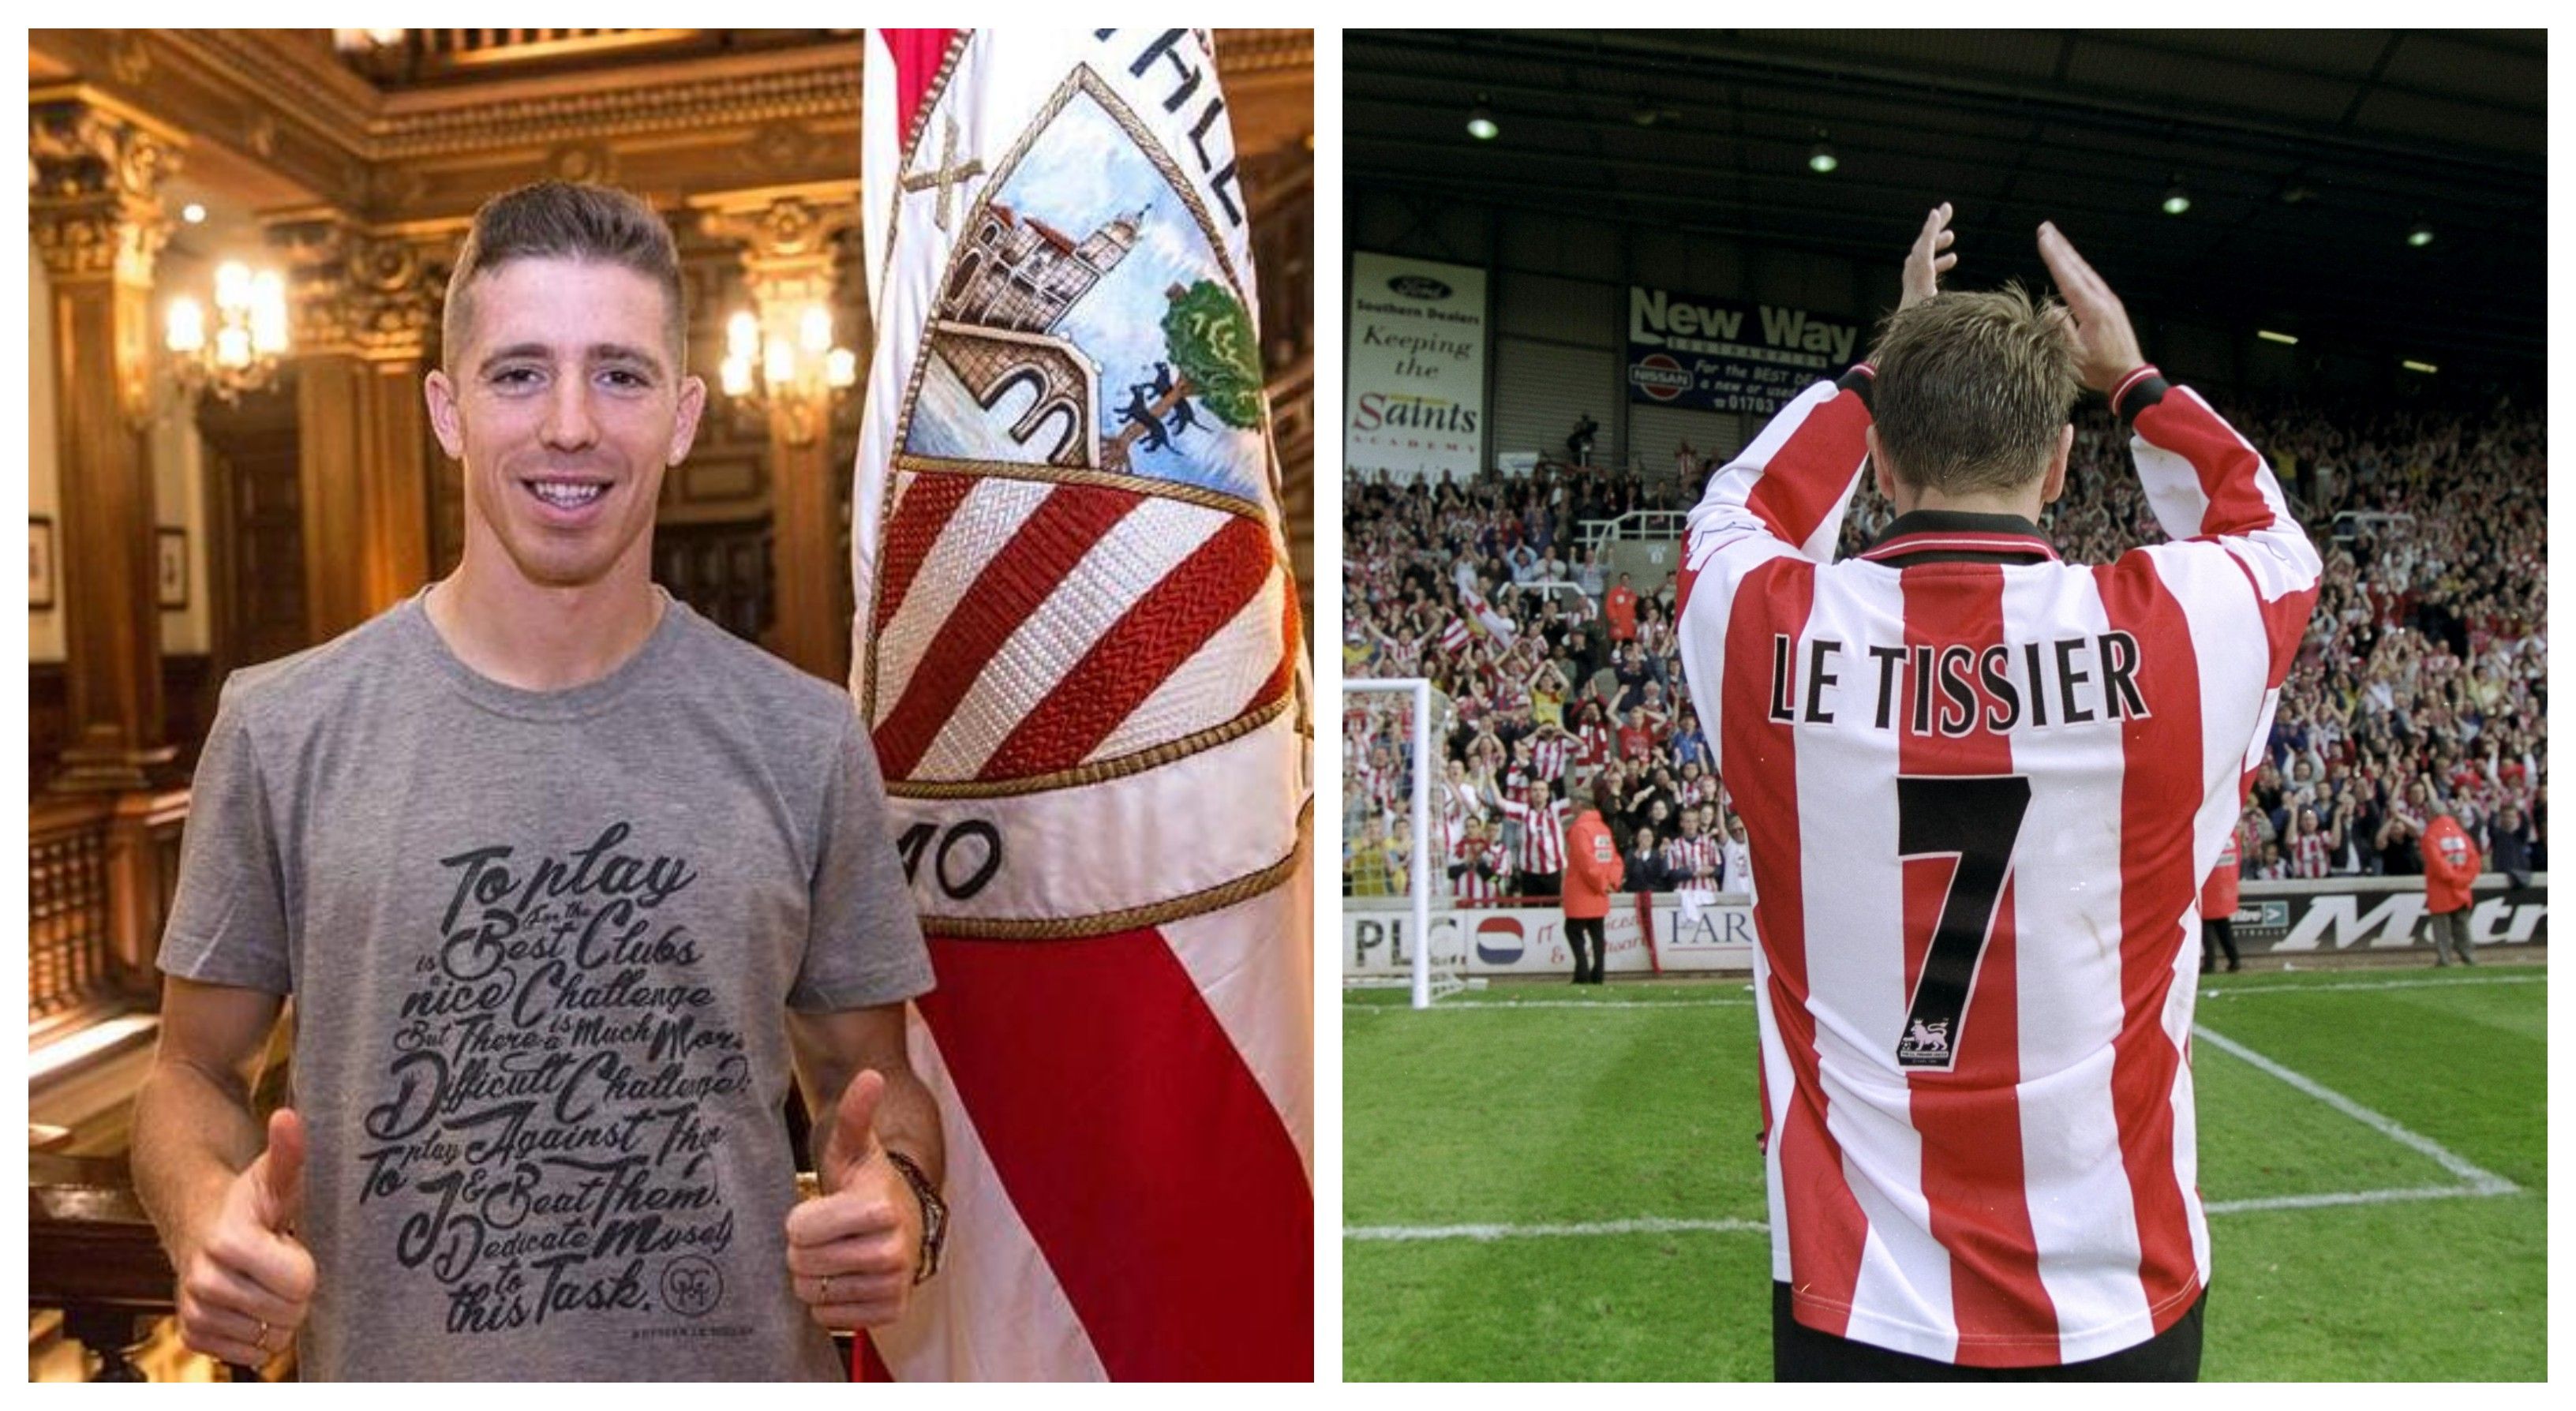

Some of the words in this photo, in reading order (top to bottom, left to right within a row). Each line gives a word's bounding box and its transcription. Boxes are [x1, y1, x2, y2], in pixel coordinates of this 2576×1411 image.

[1363, 325, 1473, 359] Keeping
[1630, 286, 1743, 341] New
[1759, 305, 1857, 365] Way
[1395, 357, 1439, 378] the
[1633, 369, 1689, 386] NISSAN
[1714, 380, 1743, 393] new
[1753, 366, 1791, 384] BEST
[1354, 392, 1477, 433] Saints
[1768, 634, 1842, 725] LE
[1868, 630, 2152, 738] TISSIER
[440, 845, 522, 936] To
[515, 822, 697, 914] play
[440, 908, 578, 981] Best
[576, 899, 703, 970] Clubs
[1896, 774, 2032, 1072] 7
[400, 967, 517, 1018] nice
[511, 960, 715, 1028] Challenge
[394, 1020, 451, 1051] But
[453, 1013, 541, 1067] There
[571, 1012, 654, 1048] Much
[365, 1050, 578, 1140] Difficult
[359, 1147, 408, 1204] To
[402, 1130, 462, 1167] play
[442, 1102, 657, 1166] Against
[481, 1162, 605, 1229] Beat
[432, 1214, 590, 1285] Dedicate
[446, 1280, 533, 1334] this
